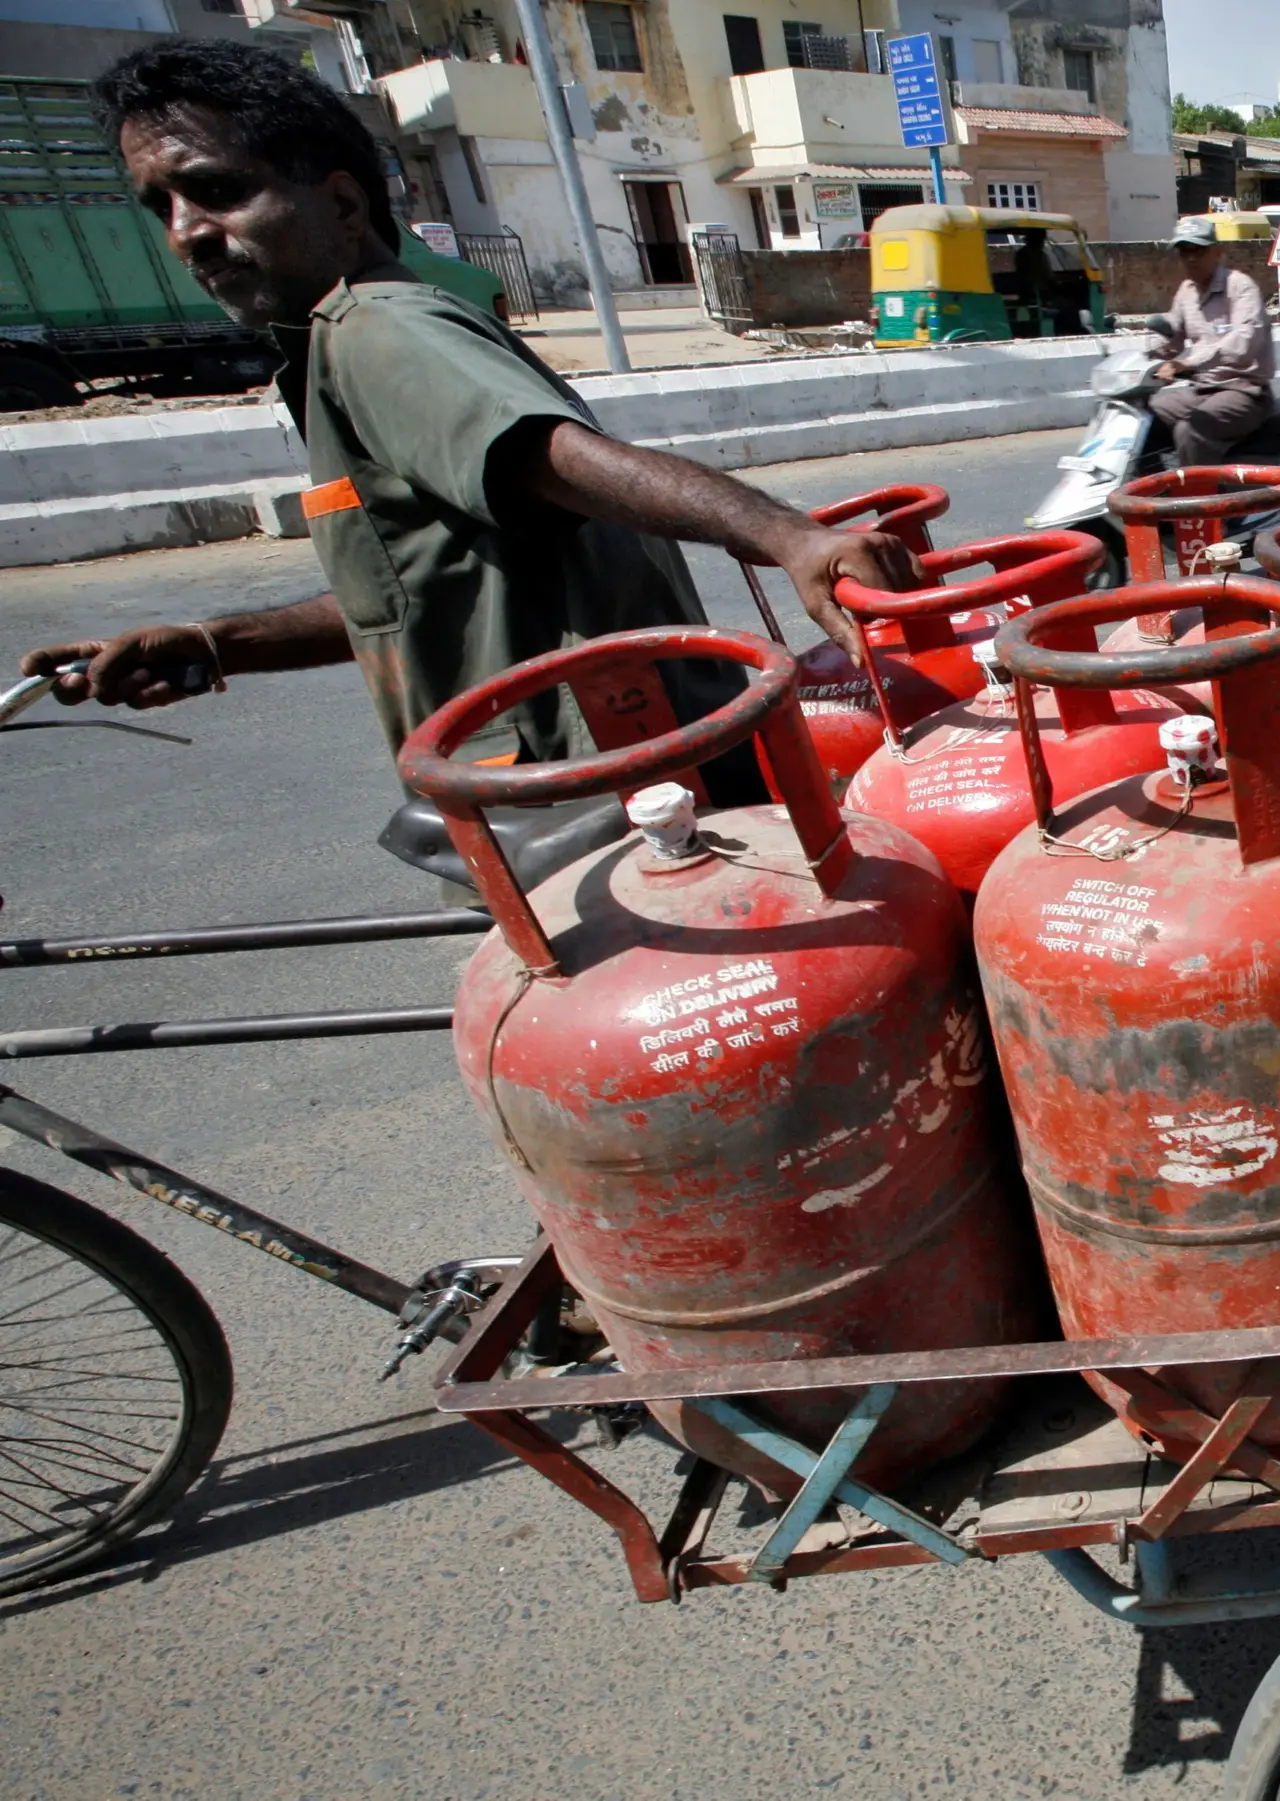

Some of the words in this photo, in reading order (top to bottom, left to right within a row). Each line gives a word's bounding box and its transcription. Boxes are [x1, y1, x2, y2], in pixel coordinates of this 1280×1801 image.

[909, 782, 954, 799] CHECK
[956, 779, 990, 791] SEAL
[927, 792, 994, 809] DELIVERY
[1071, 878, 1125, 894] SWITCH
[1127, 885, 1158, 900] OFF
[1064, 890, 1150, 914] REGULATOR
[1081, 906, 1114, 921] NOT
[1113, 911, 1131, 926] IN
[641, 973, 715, 1007] CHECK
[715, 958, 775, 983] SEAL
[640, 1017, 712, 1054] डिलिवरी
[649, 1050, 690, 1075] सील
[148, 1183, 295, 1262] NEELAM
